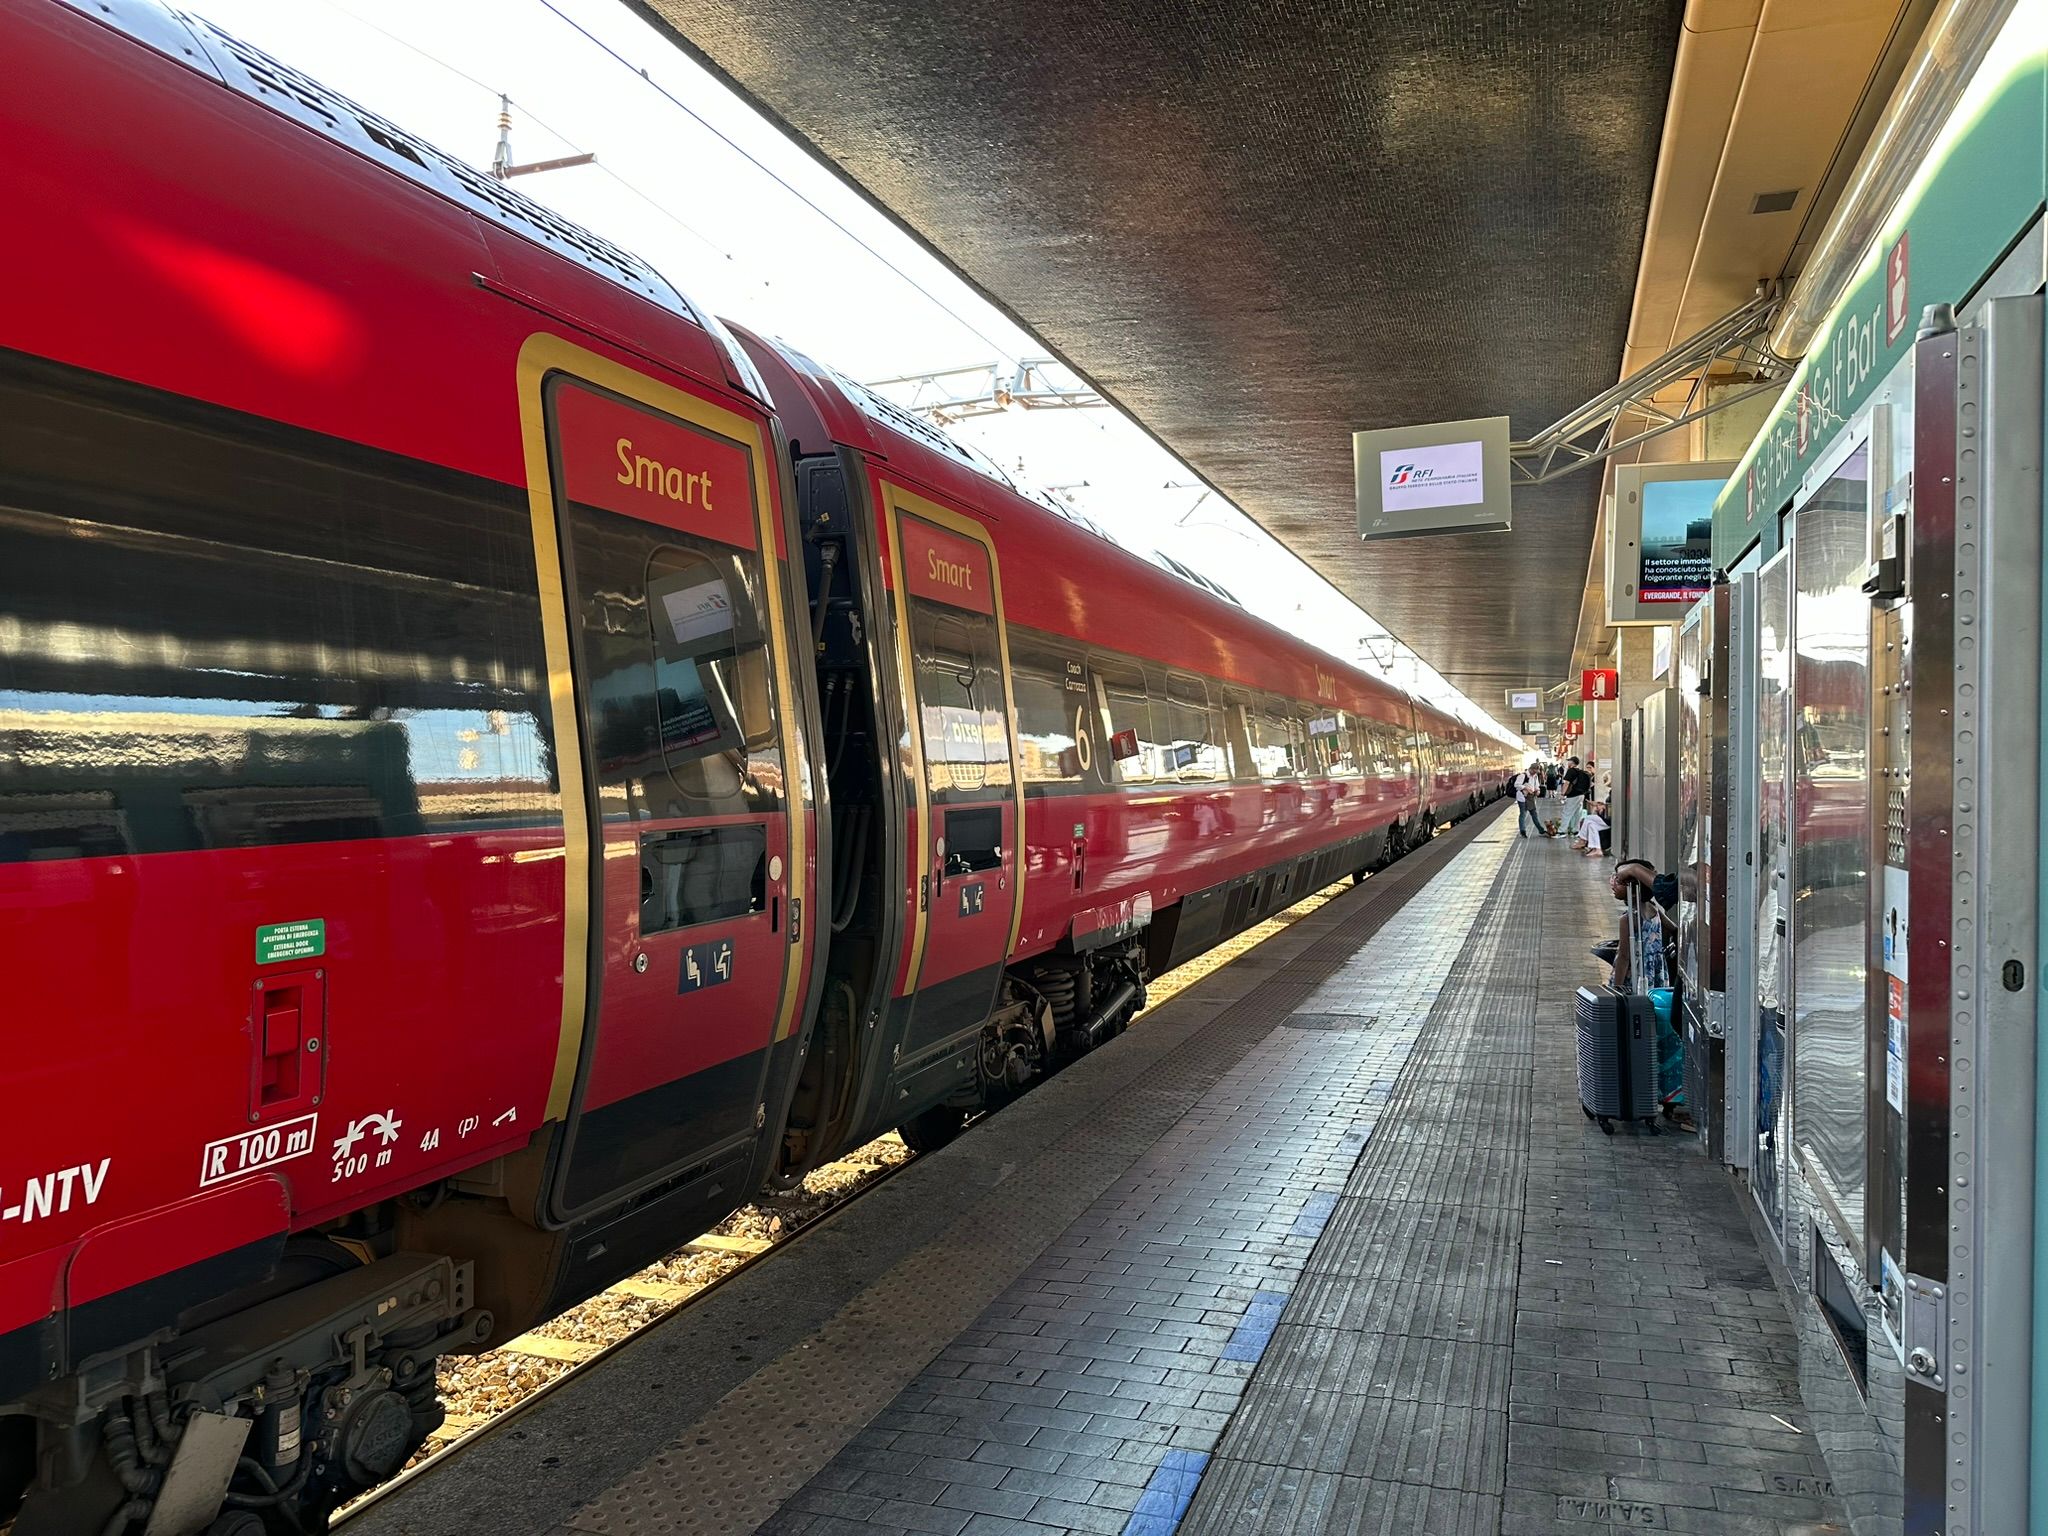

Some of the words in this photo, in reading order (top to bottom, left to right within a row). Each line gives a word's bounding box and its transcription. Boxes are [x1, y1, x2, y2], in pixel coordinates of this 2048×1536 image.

[1812, 327, 1844, 441] Self
[1847, 304, 1881, 398] Bar
[616, 438, 713, 511] Smart
[1413, 469, 1434, 479] RFI
[1755, 430, 1774, 513] Self
[1775, 425, 1795, 489] Bar
[928, 548, 973, 591] Smart
[1644, 574, 1683, 582] folgorante
[1683, 574, 1702, 582] negli
[1645, 566, 1655, 574] ha
[1655, 566, 1697, 574] conosciuto
[1066, 661, 1082, 675] Coach
[1075, 704, 1092, 771] 6
[263, 934, 287, 943] APERTURA
[274, 926, 289, 934] PORTA
[289, 924, 308, 932] ESTERNA
[267, 949, 294, 959] EMERGENCY
[273, 942, 295, 950] EXTERNAL
[420, 1127, 440, 1151] 4A
[209, 1146, 227, 1177] R
[238, 1130, 281, 1168] 100
[287, 1127, 308, 1149] m
[331, 1155, 368, 1183] 500
[376, 1148, 392, 1166] m
[0, 1157, 112, 1223] -NTV
